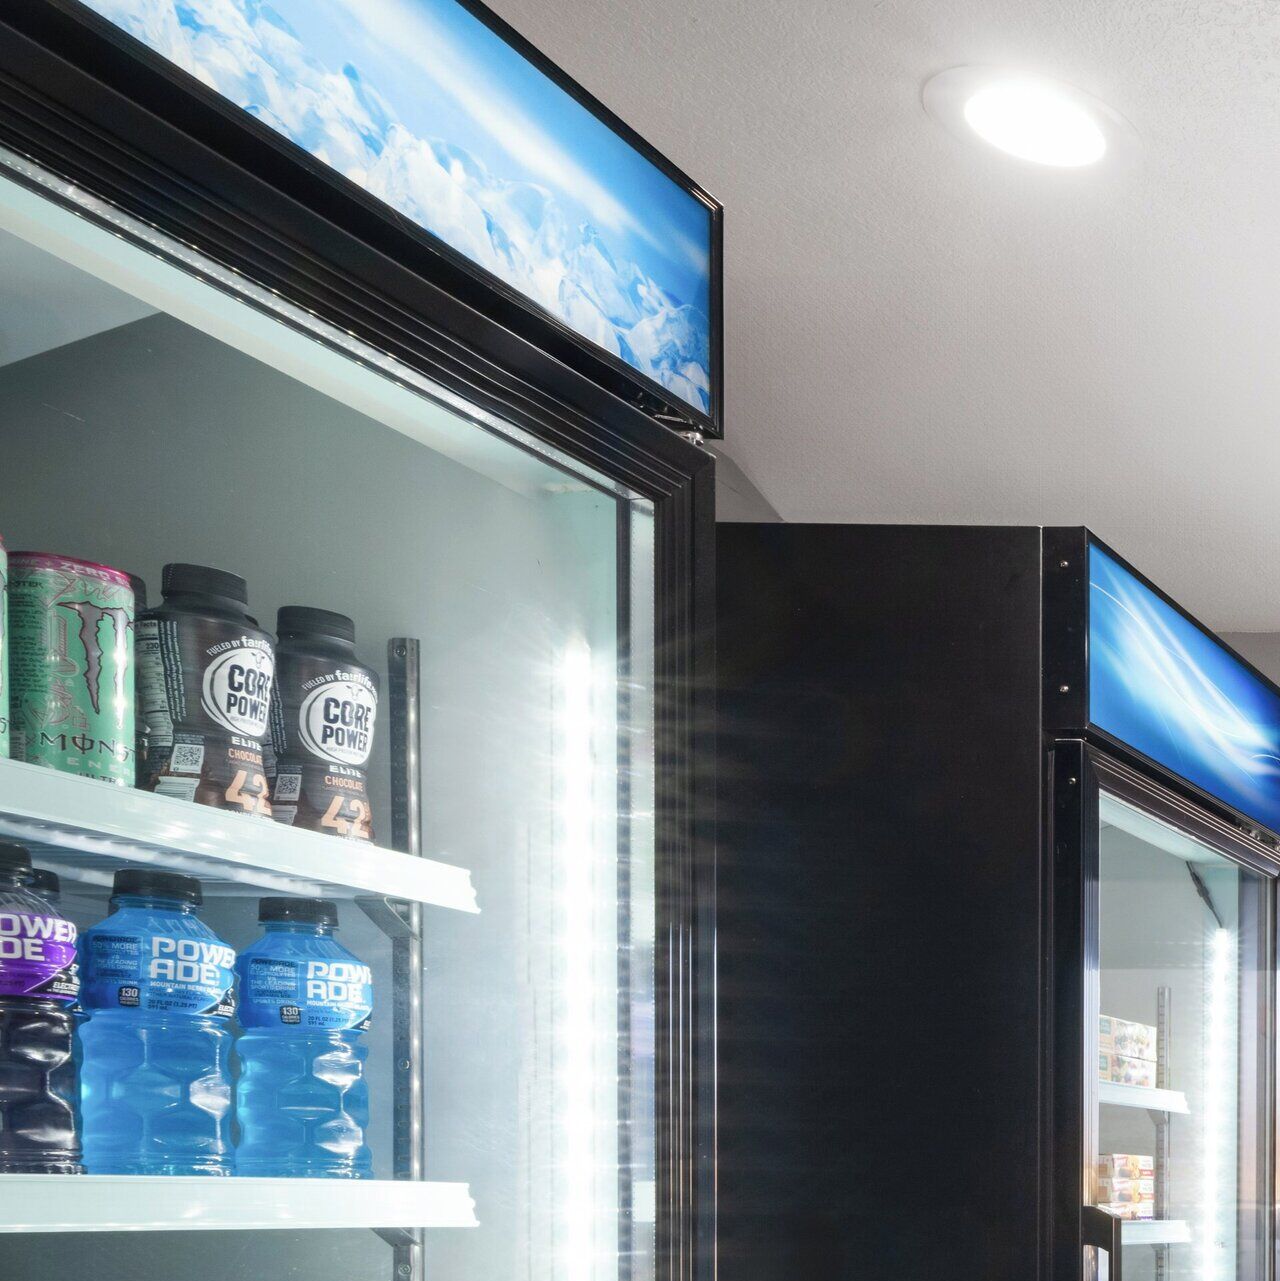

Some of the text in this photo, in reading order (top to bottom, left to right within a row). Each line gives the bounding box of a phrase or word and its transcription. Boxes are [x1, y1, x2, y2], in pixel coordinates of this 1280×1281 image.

[206, 641, 232, 657] FUELED
[232, 639, 241, 648] BY
[228, 664, 270, 701] CORE
[302, 676, 326, 691] FUELED
[325, 673, 335, 683] BY
[323, 697, 372, 733] CORE
[321, 724, 368, 753] POWER
[225, 769, 273, 817] 42
[320, 795, 370, 839] 42
[121, 987, 139, 998] 130
[281, 1006, 299, 1017] 130
